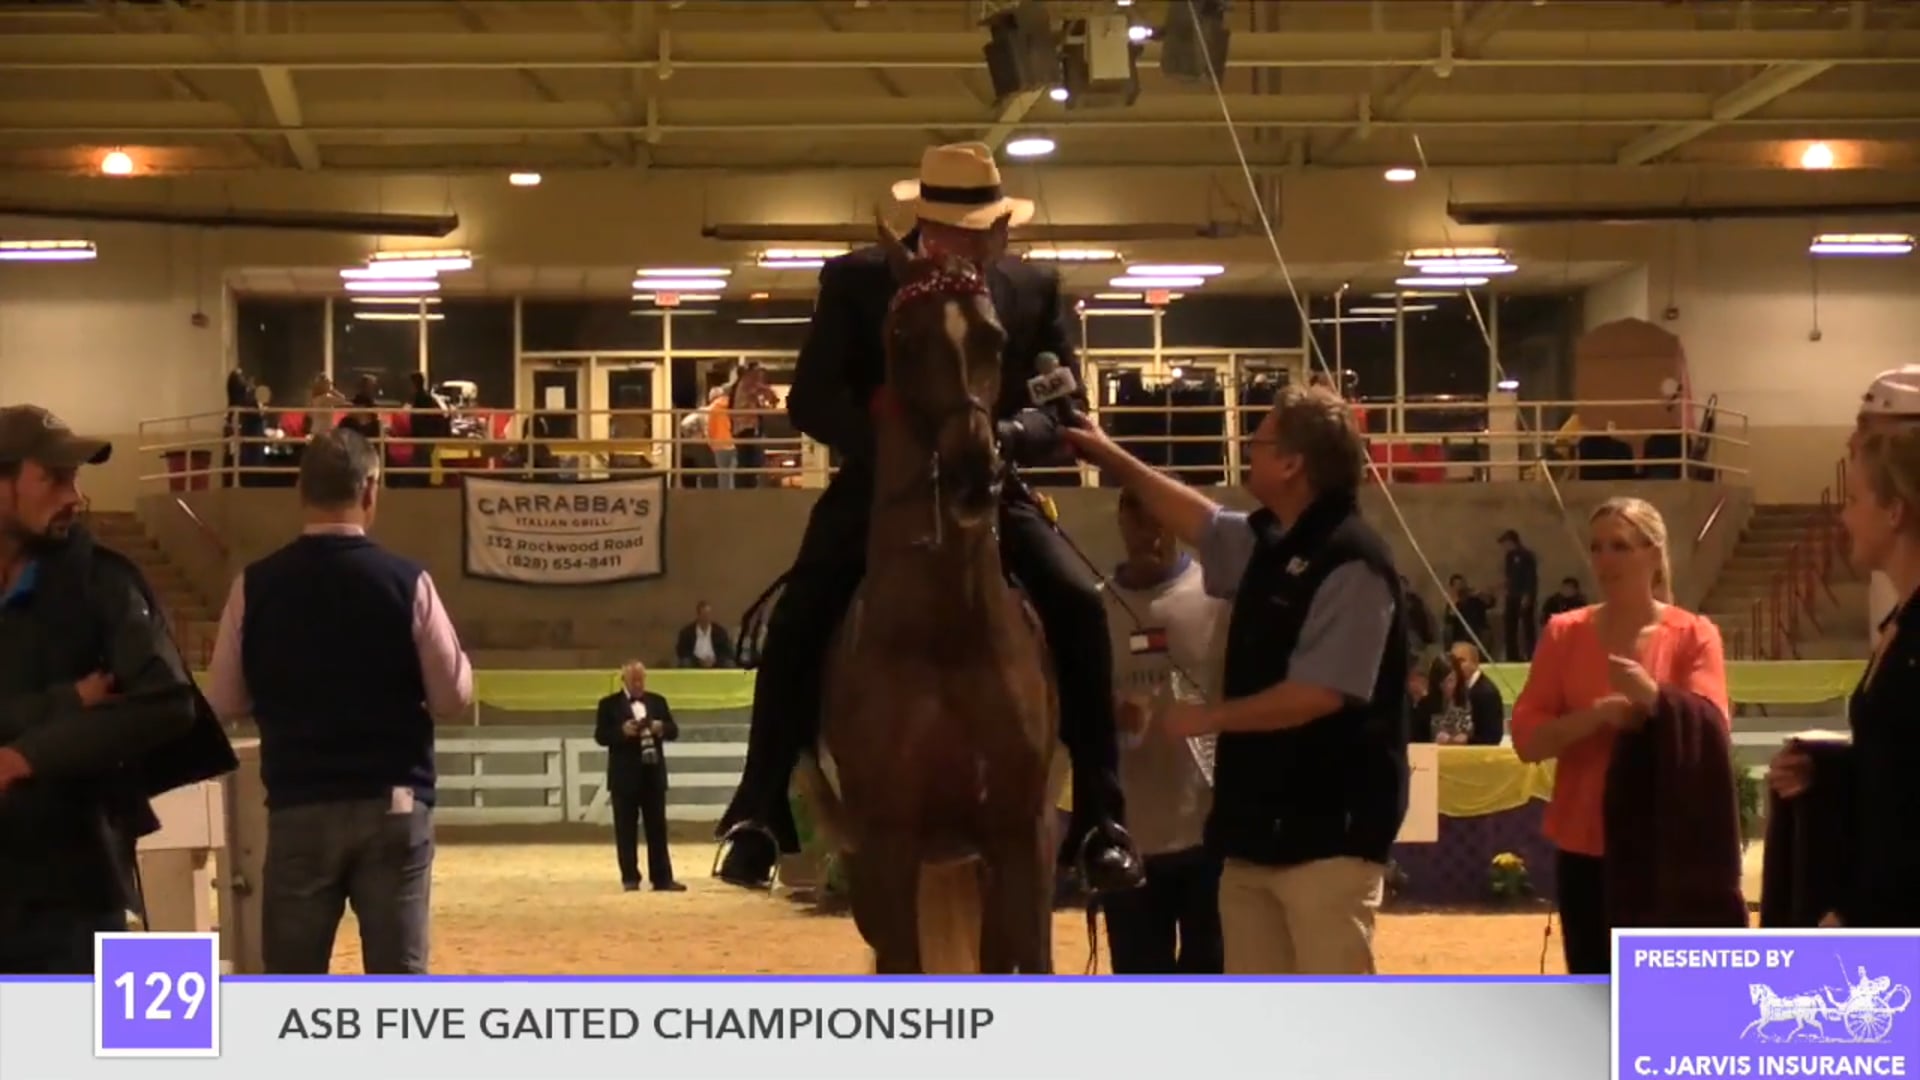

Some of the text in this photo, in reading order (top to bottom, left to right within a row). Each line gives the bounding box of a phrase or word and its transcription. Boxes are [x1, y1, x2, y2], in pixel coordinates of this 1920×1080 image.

[477, 495, 651, 516] CARRABBA'S
[516, 517, 610, 528] ITALIAN GRILL
[517, 538, 600, 554] Rockwood
[604, 535, 644, 551] Road
[506, 554, 621, 571] (828) 654-8411
